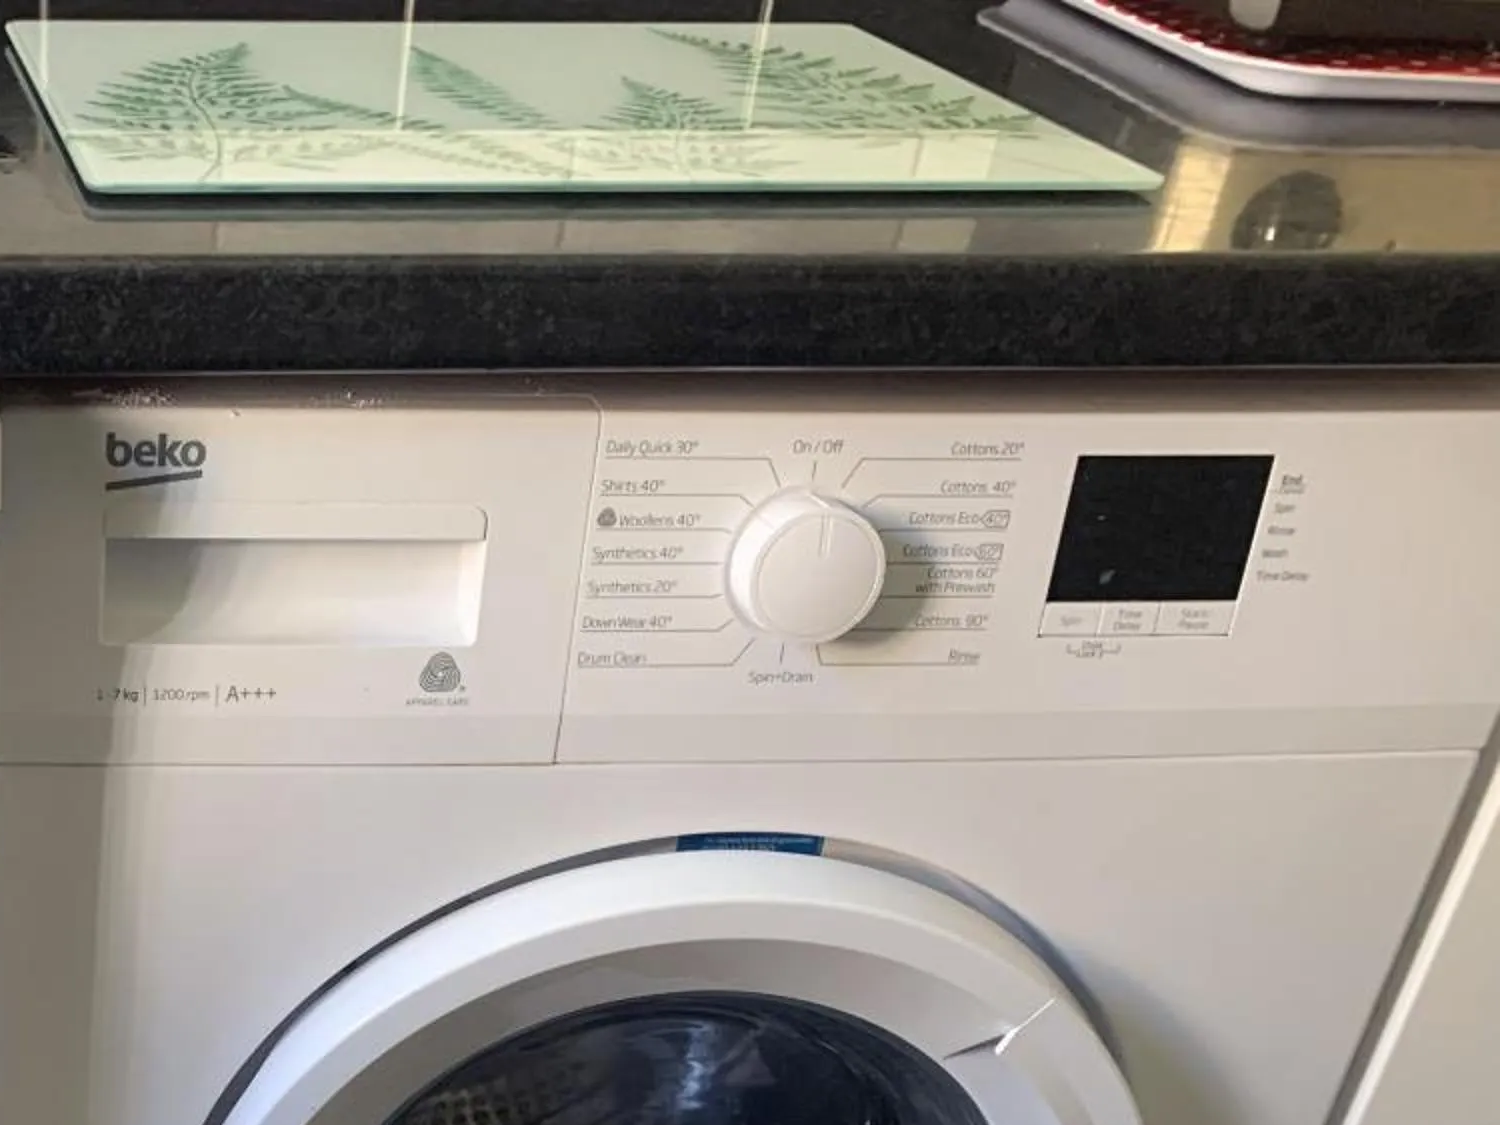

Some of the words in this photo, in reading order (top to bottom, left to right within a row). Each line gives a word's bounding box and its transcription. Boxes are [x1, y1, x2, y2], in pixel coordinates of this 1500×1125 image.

[106, 432, 206, 467] beko
[606, 440, 635, 457] Daily
[640, 440, 672, 457] Quick
[793, 439, 812, 453] On
[824, 439, 844, 453] Off
[951, 441, 999, 455] Cottons
[601, 479, 636, 492] Shirts
[641, 479, 665, 492] 40°
[941, 480, 987, 493] Cottons
[992, 480, 1016, 492] 40°
[619, 514, 673, 527] Woollens
[909, 512, 956, 524] Cottons
[958, 511, 980, 524] Eco
[593, 547, 655, 562] Synthetics
[660, 547, 684, 559] 40°
[903, 544, 950, 557] Cottons
[951, 543, 973, 557] Eco
[927, 567, 974, 579] Cottons
[587, 580, 650, 597] Synthetics
[654, 580, 678, 592] 20°
[649, 615, 673, 628] 40°
[915, 615, 962, 627] Cottons
[578, 651, 611, 667] Drum
[614, 651, 647, 666] Clean
[748, 672, 813, 685] Spin+Drain
[225, 685, 276, 703] A+++
